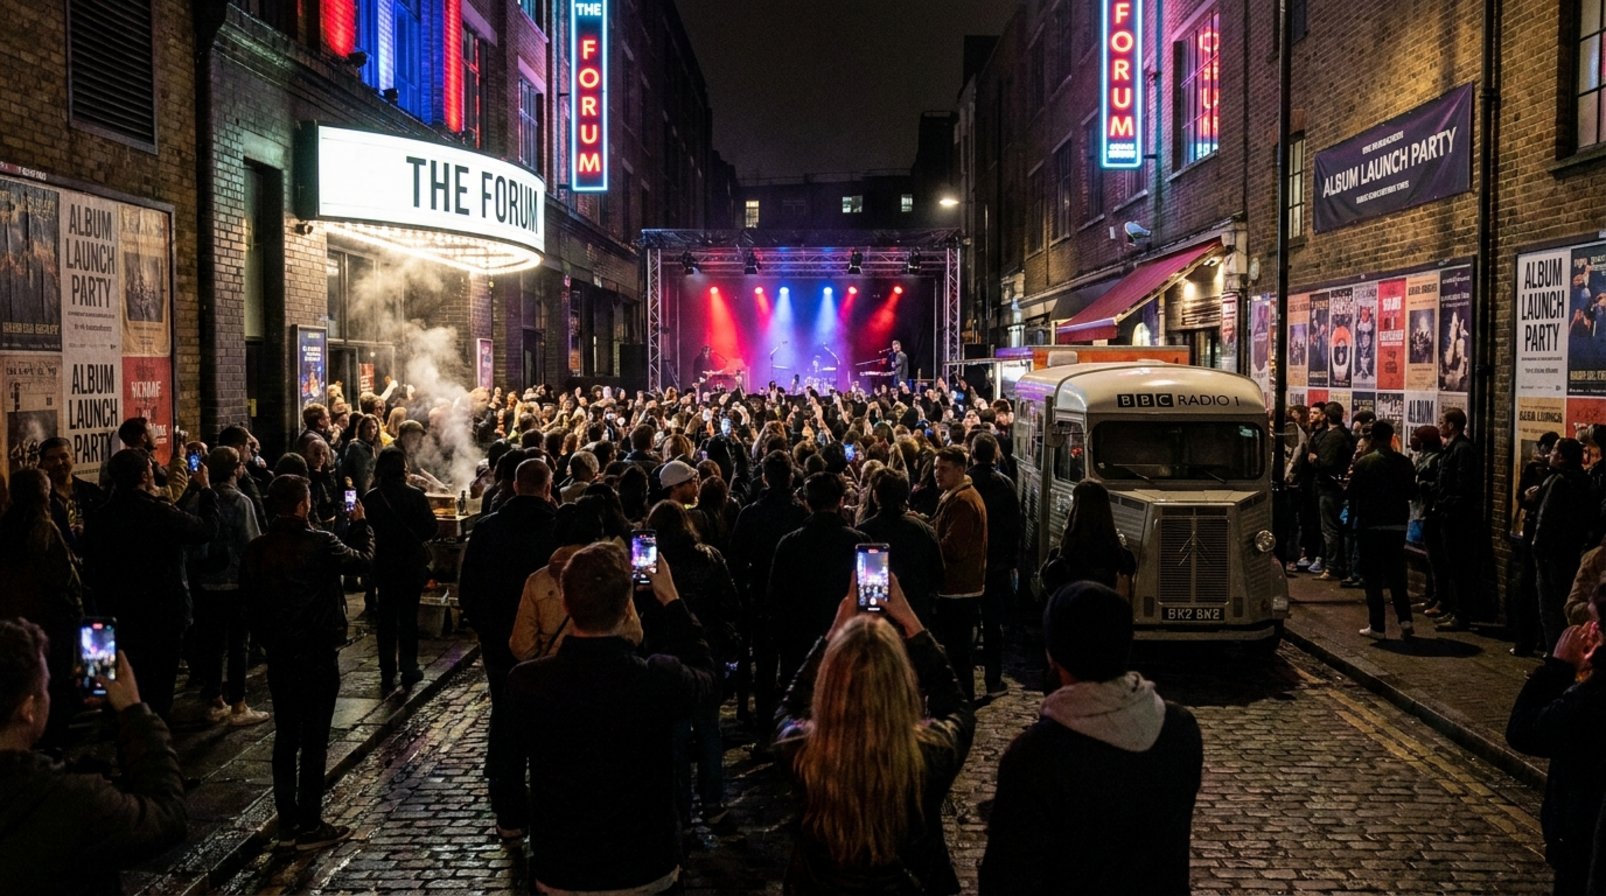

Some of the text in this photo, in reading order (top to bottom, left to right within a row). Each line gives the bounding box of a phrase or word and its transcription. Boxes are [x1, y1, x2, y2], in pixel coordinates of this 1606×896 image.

[576, 3, 602, 16] THE
[1110, 3, 1134, 137] FORUM
[578, 40, 601, 172] FORUM
[1323, 165, 1358, 198] ALBUM
[1361, 147, 1408, 185] LAUNCH
[1411, 126, 1457, 167] PARTY
[406, 156, 538, 234] THE FORUM
[69, 204, 112, 242] ALBUM
[66, 238, 115, 275] LAUNCH
[1524, 258, 1562, 290] ALBUM
[71, 275, 111, 308] PARTY
[1521, 290, 1564, 321] LAUNCH
[1525, 323, 1560, 352] PARTY
[71, 364, 114, 396] ALBUM
[68, 397, 118, 430] LAUNCH
[1117, 393, 1240, 408] BBC RADIO 1
[74, 433, 114, 465] PARTY
